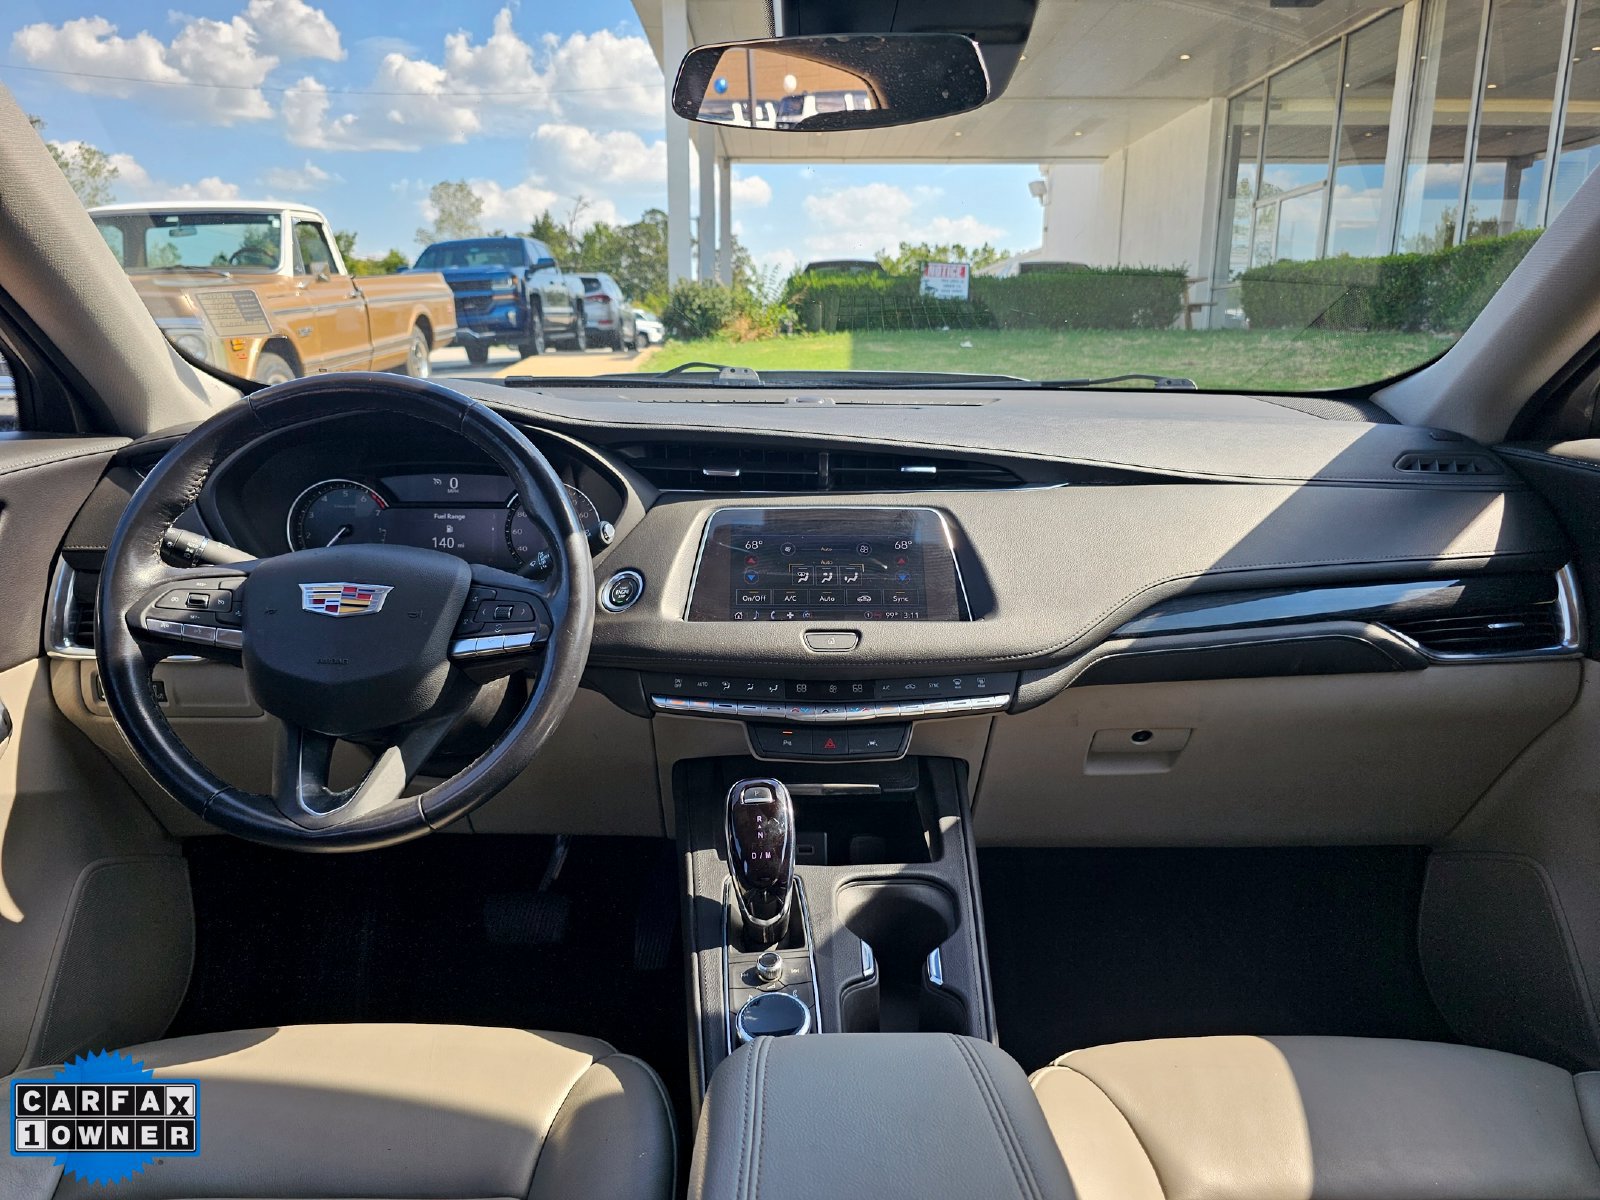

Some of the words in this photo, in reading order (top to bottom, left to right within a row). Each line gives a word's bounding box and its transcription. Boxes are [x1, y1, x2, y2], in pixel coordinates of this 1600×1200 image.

[449, 477, 459, 489] 0
[360, 495, 367, 503] 6
[375, 509, 381, 517] 7
[447, 513, 466, 521] Range
[431, 537, 455, 549] 140
[742, 595, 766, 603] On/Off
[784, 595, 797, 603] A/C
[892, 596, 909, 604] Sync
